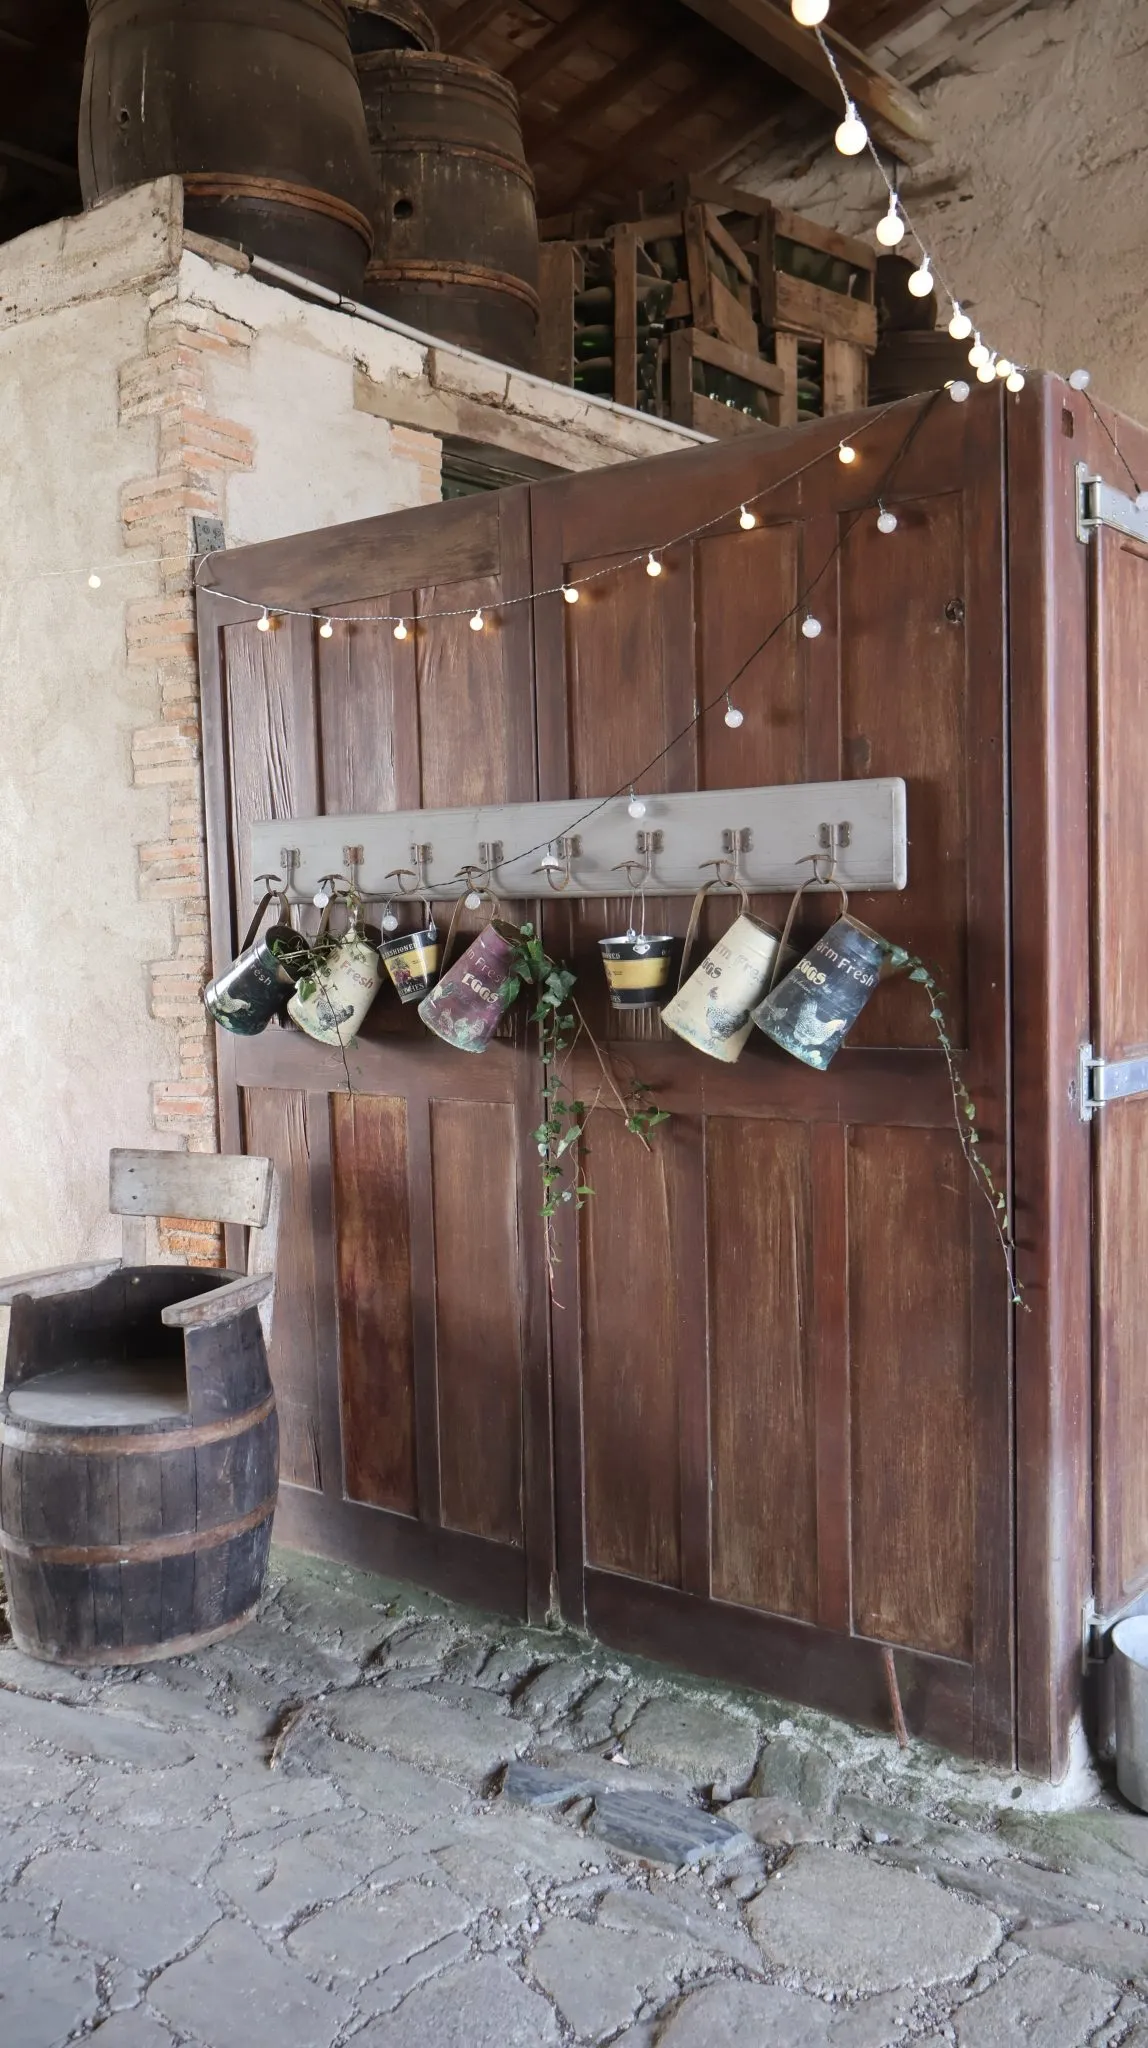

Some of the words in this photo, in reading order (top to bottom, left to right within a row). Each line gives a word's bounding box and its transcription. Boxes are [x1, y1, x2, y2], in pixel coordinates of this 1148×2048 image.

[340, 960, 374, 989] Fresh
[816, 939, 839, 962] arm
[838, 958, 875, 987] Fresh
[461, 973, 499, 1003] EGGS
